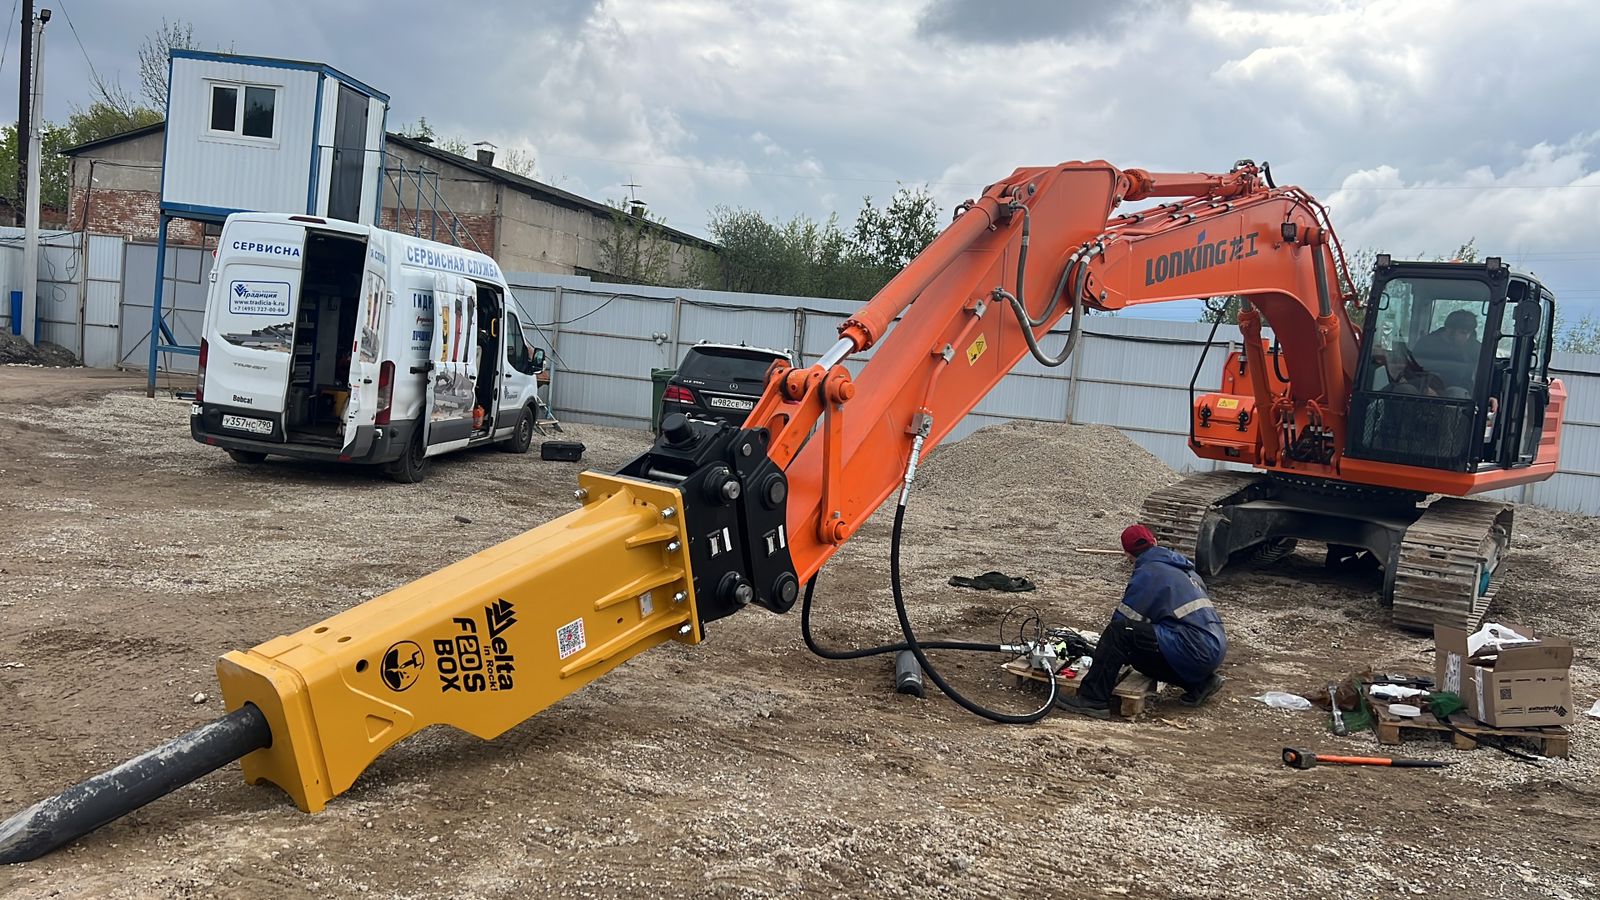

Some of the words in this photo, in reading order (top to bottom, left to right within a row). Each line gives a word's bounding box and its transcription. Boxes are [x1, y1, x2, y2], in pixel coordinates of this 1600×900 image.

[233, 241, 300, 257] СЕРВИСНА
[407, 245, 465, 272] СЕРВИСНАЯ
[467, 260, 499, 278] СЛУЖБА
[243, 290, 278, 298] Традиция
[234, 299, 285, 307] www.tradicia-k.ru
[232, 394, 253, 405] Bobcat
[452, 617, 486, 692] F20S
[484, 646, 491, 656] in
[433, 639, 462, 693] BOX
[486, 659, 498, 691] Rock!
